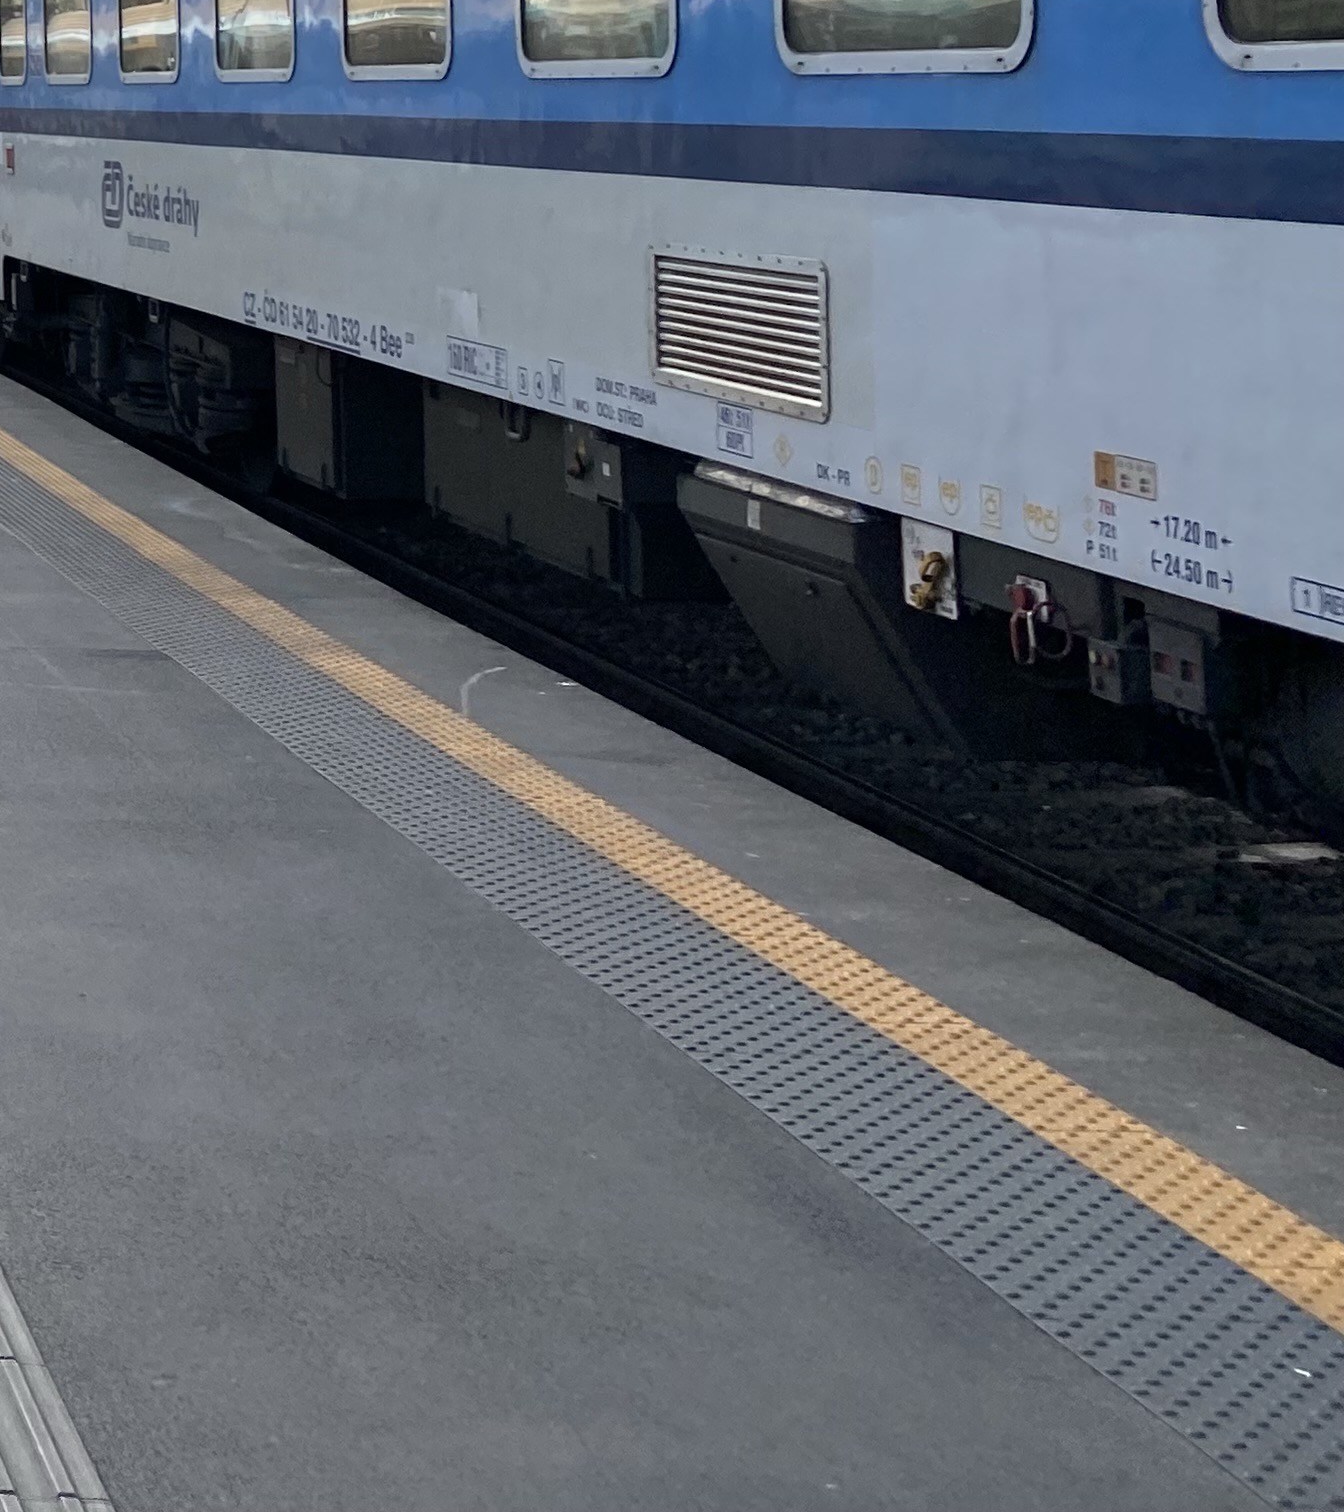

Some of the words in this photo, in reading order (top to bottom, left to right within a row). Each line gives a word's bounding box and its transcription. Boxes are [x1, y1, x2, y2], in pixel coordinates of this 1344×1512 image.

[127, 174, 160, 221] České
[163, 186, 199, 238] dráhy
[244, 292, 256, 318] CZ
[293, 304, 303, 331] 54
[306, 307, 318, 336] 20
[327, 313, 339, 341] 70
[342, 317, 360, 346] 532
[371, 325, 377, 351] 4
[380, 325, 402, 358] Bee
[1163, 515, 1201, 546] 17.20
[1205, 530, 1218, 550] m
[1164, 553, 1202, 585] 24.50
[1206, 570, 1219, 590] m
